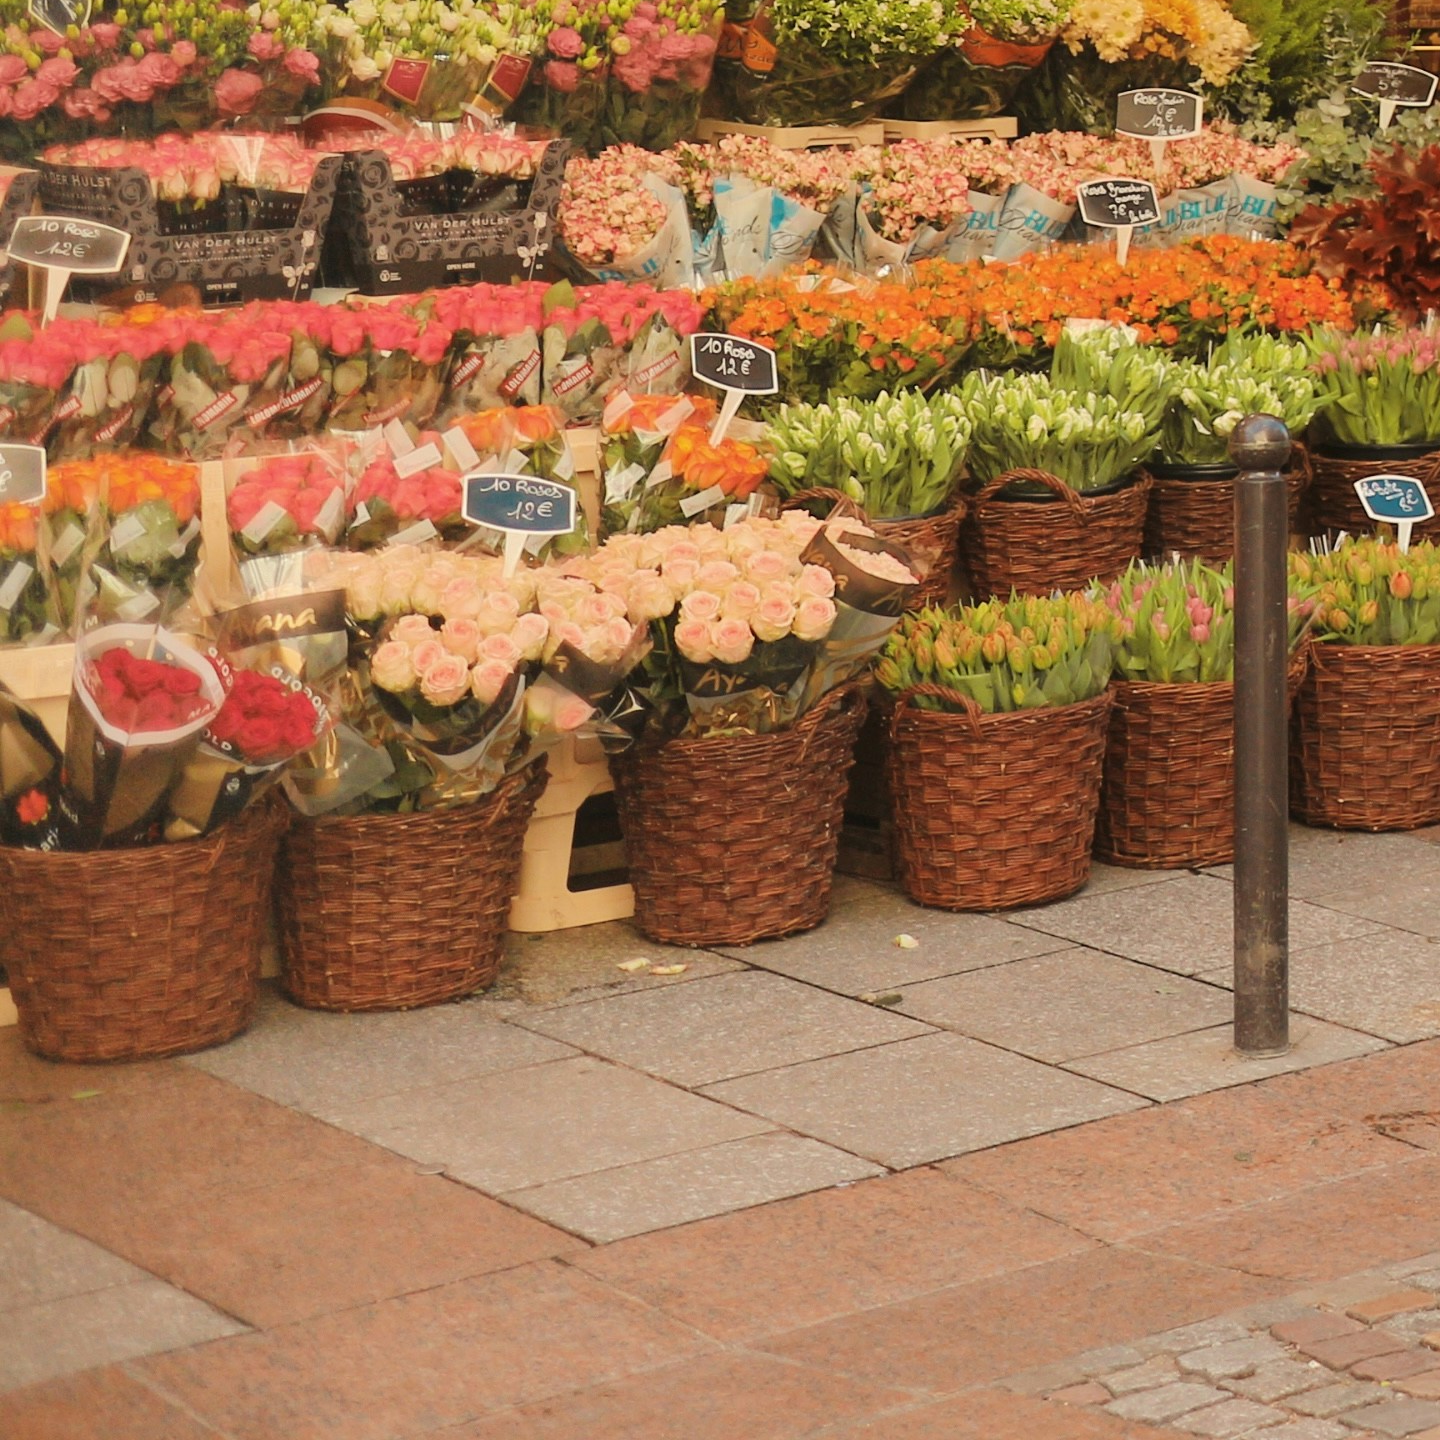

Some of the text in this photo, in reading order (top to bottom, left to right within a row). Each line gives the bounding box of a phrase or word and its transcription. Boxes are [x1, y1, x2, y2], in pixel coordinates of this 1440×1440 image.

[72, 174, 112, 188] HULST
[29, 220, 59, 232] 10
[414, 217, 511, 231] VAN DER HULST
[175, 235, 278, 250] VAN DER HULST
[206, 283, 221, 291] OPEN
[700, 337, 722, 354] 10
[480, 479, 563, 499] 10 Roses
[507, 501, 554, 521] 12€
